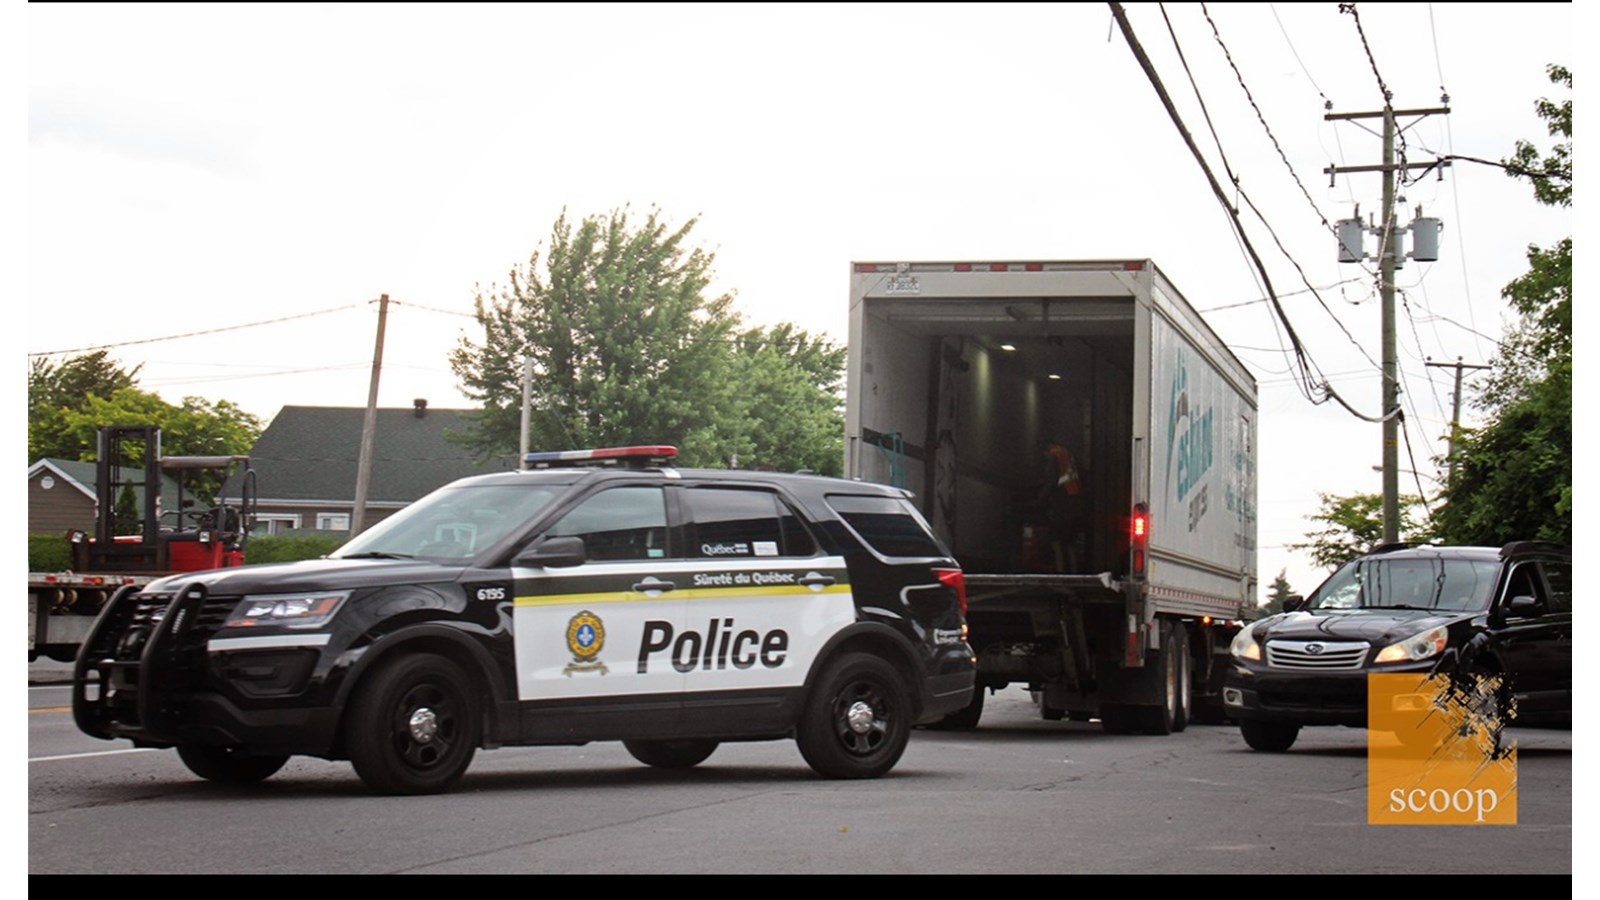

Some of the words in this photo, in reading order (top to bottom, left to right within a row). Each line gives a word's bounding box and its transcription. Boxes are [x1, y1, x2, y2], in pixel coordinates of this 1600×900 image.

[701, 543, 736, 556] Québec
[693, 572, 733, 586] Sûreté
[734, 572, 750, 584] du
[752, 571, 795, 585] Québec
[477, 587, 506, 601] 6195
[637, 617, 789, 675] Police
